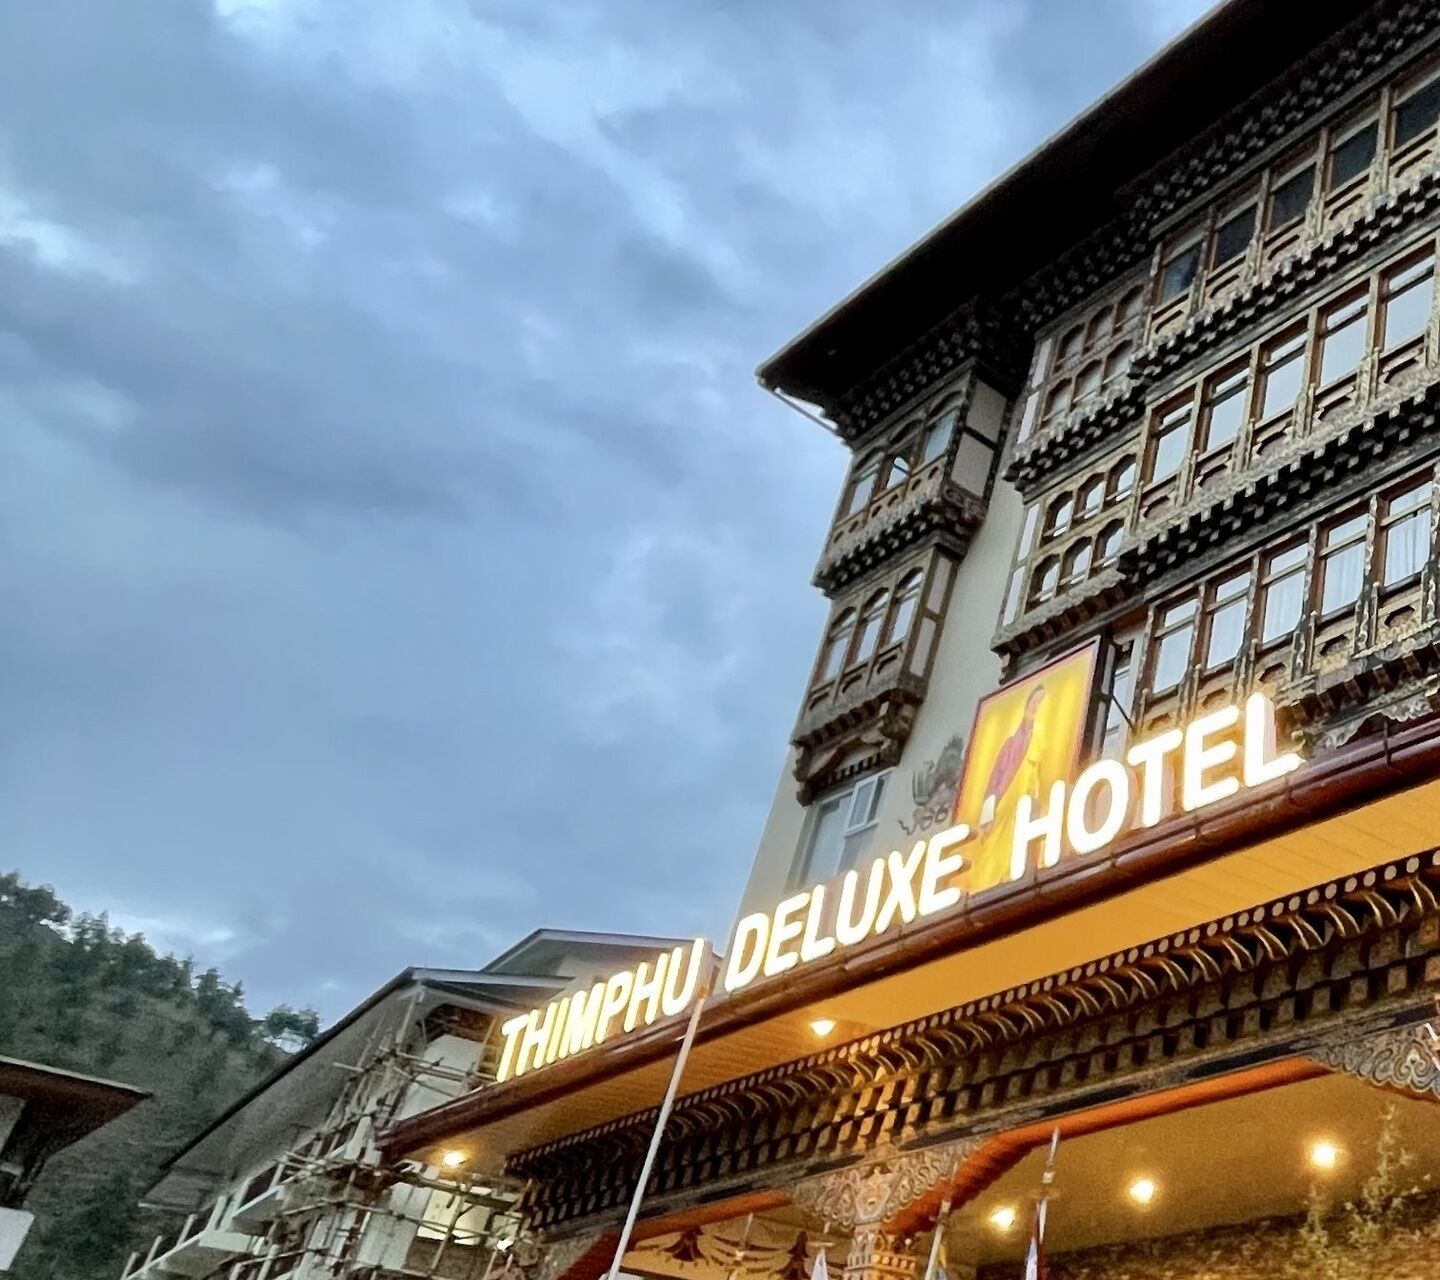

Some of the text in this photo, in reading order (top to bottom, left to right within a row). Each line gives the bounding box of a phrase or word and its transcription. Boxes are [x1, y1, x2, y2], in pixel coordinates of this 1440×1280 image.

[496, 692, 1303, 1083] THIMPHU DELUXE HOTEL
